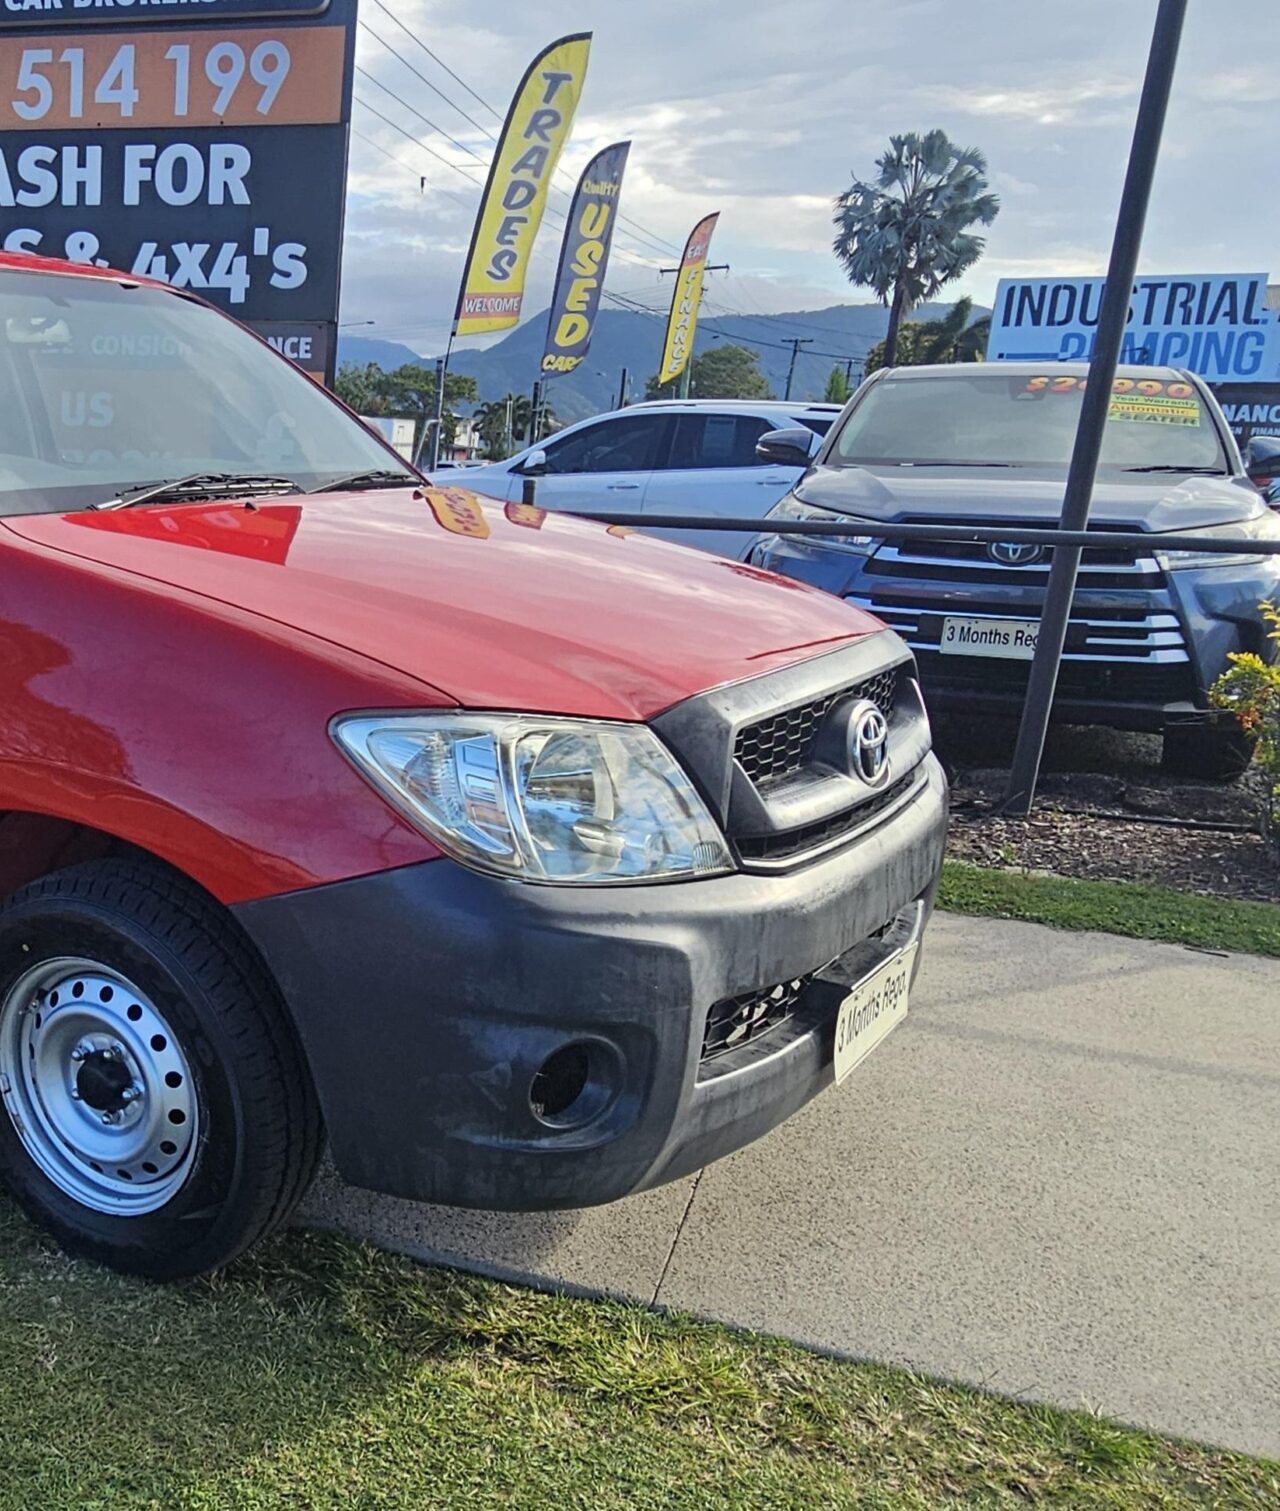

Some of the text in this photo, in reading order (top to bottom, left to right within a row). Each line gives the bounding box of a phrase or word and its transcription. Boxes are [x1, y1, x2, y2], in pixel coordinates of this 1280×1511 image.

[12, 44, 139, 120] 514
[165, 40, 291, 116] 199
[123, 143, 252, 206] FOR
[486, 72, 572, 281] TRADES
[464, 295, 520, 314] WELCOME
[554, 202, 610, 348] USED
[1058, 331, 1265, 376] PMPING
[61, 391, 115, 428] US
[946, 625, 955, 641] 3
[959, 626, 1010, 645] Months
[838, 1017, 846, 1053] 3
[846, 991, 881, 1046] Months
